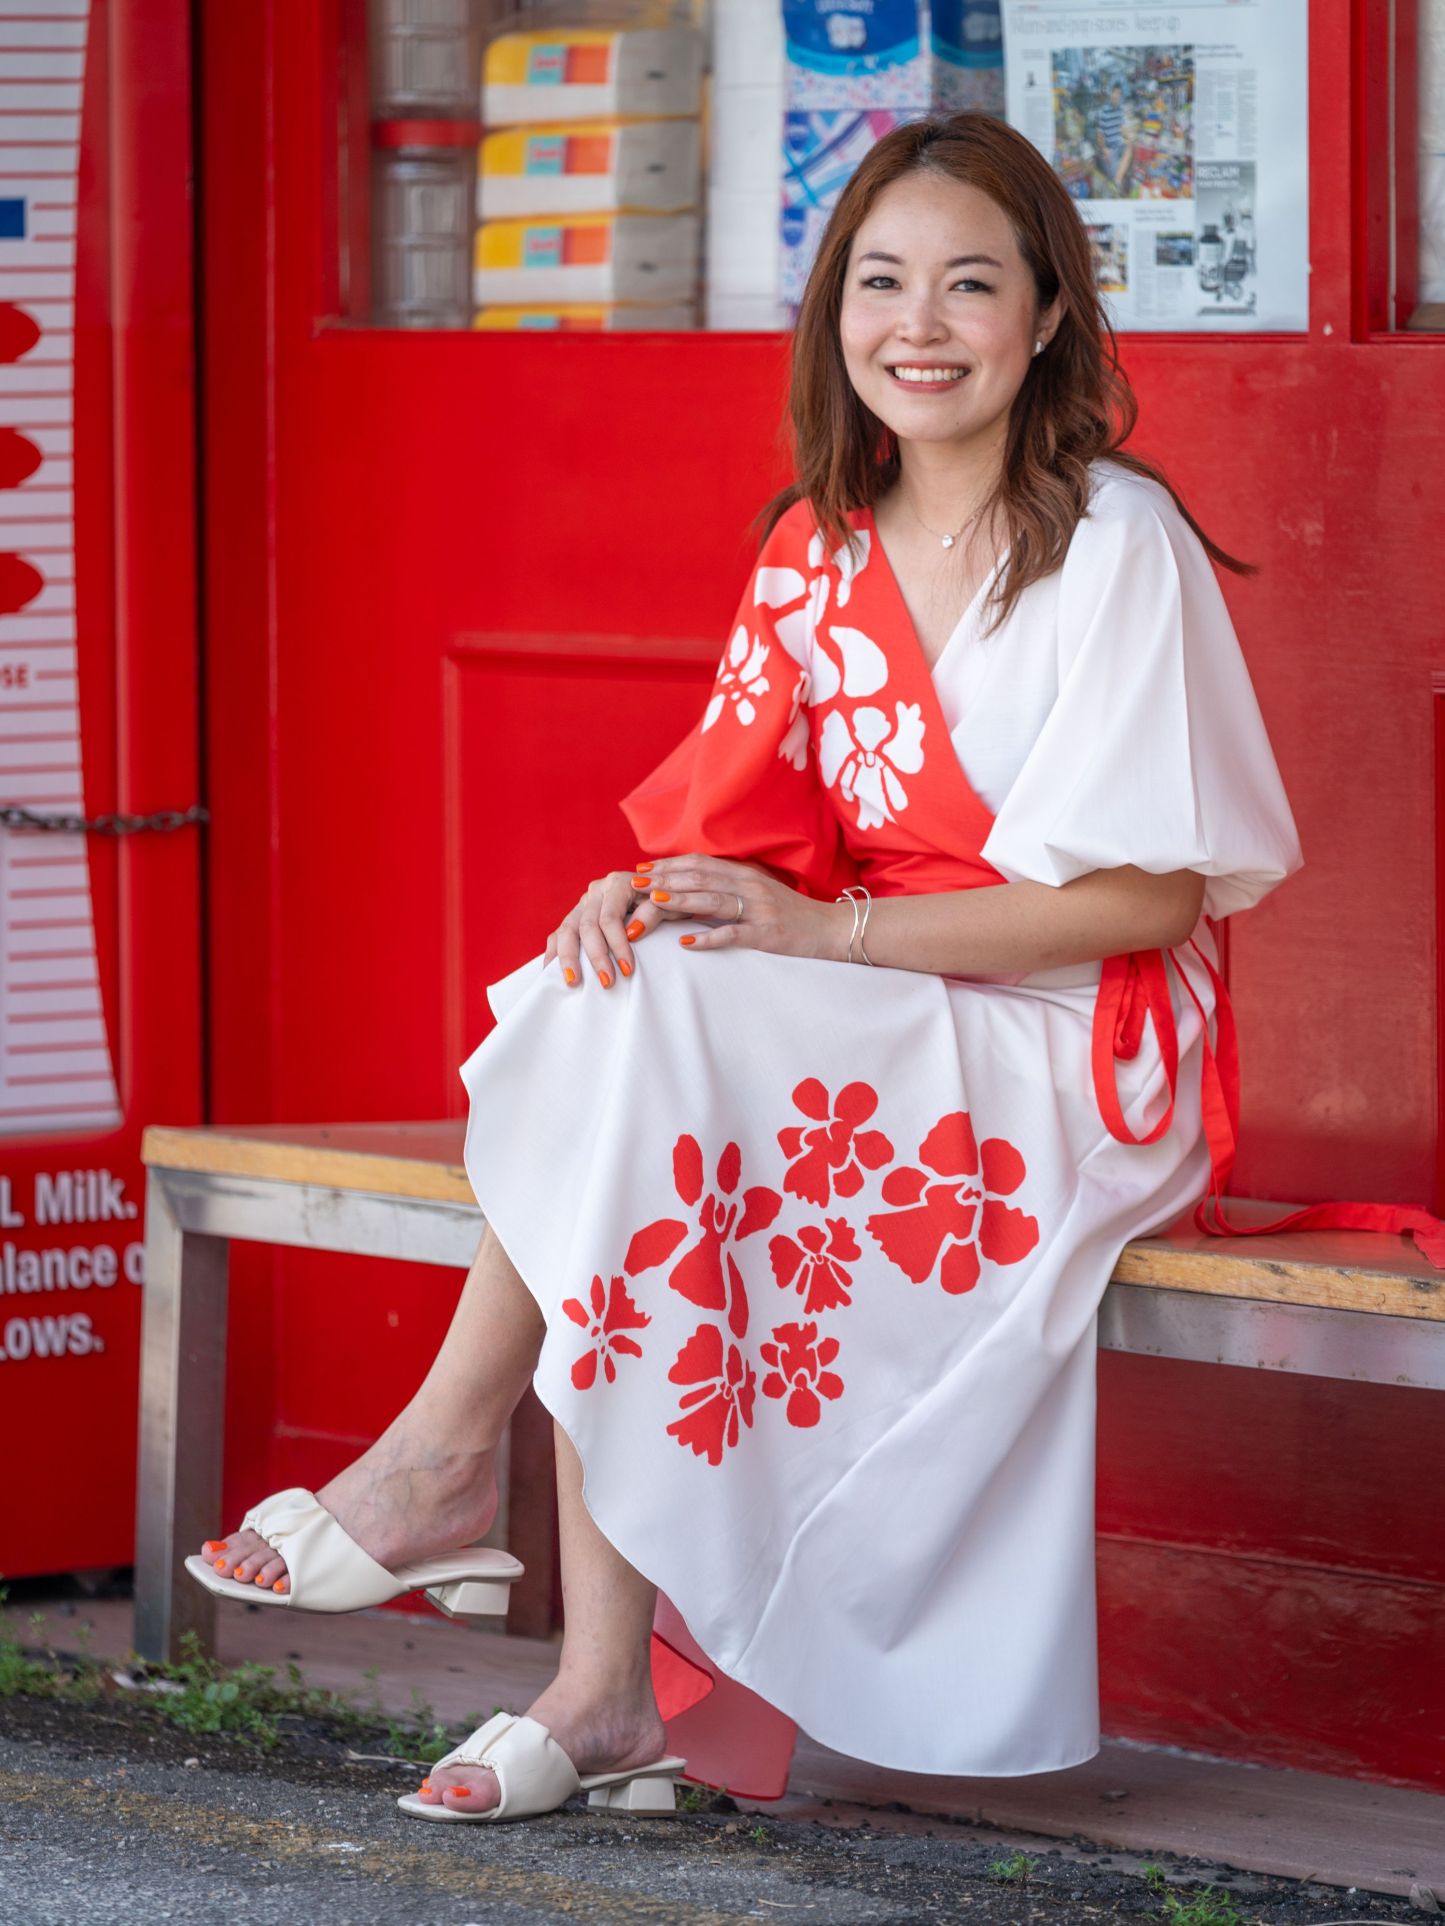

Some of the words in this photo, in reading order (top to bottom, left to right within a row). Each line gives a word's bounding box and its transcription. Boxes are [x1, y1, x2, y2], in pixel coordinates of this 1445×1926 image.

[34, 1168, 138, 1226] Milk.
[0, 1241, 118, 1295] lance
[0, 1311, 105, 1361] ows.
